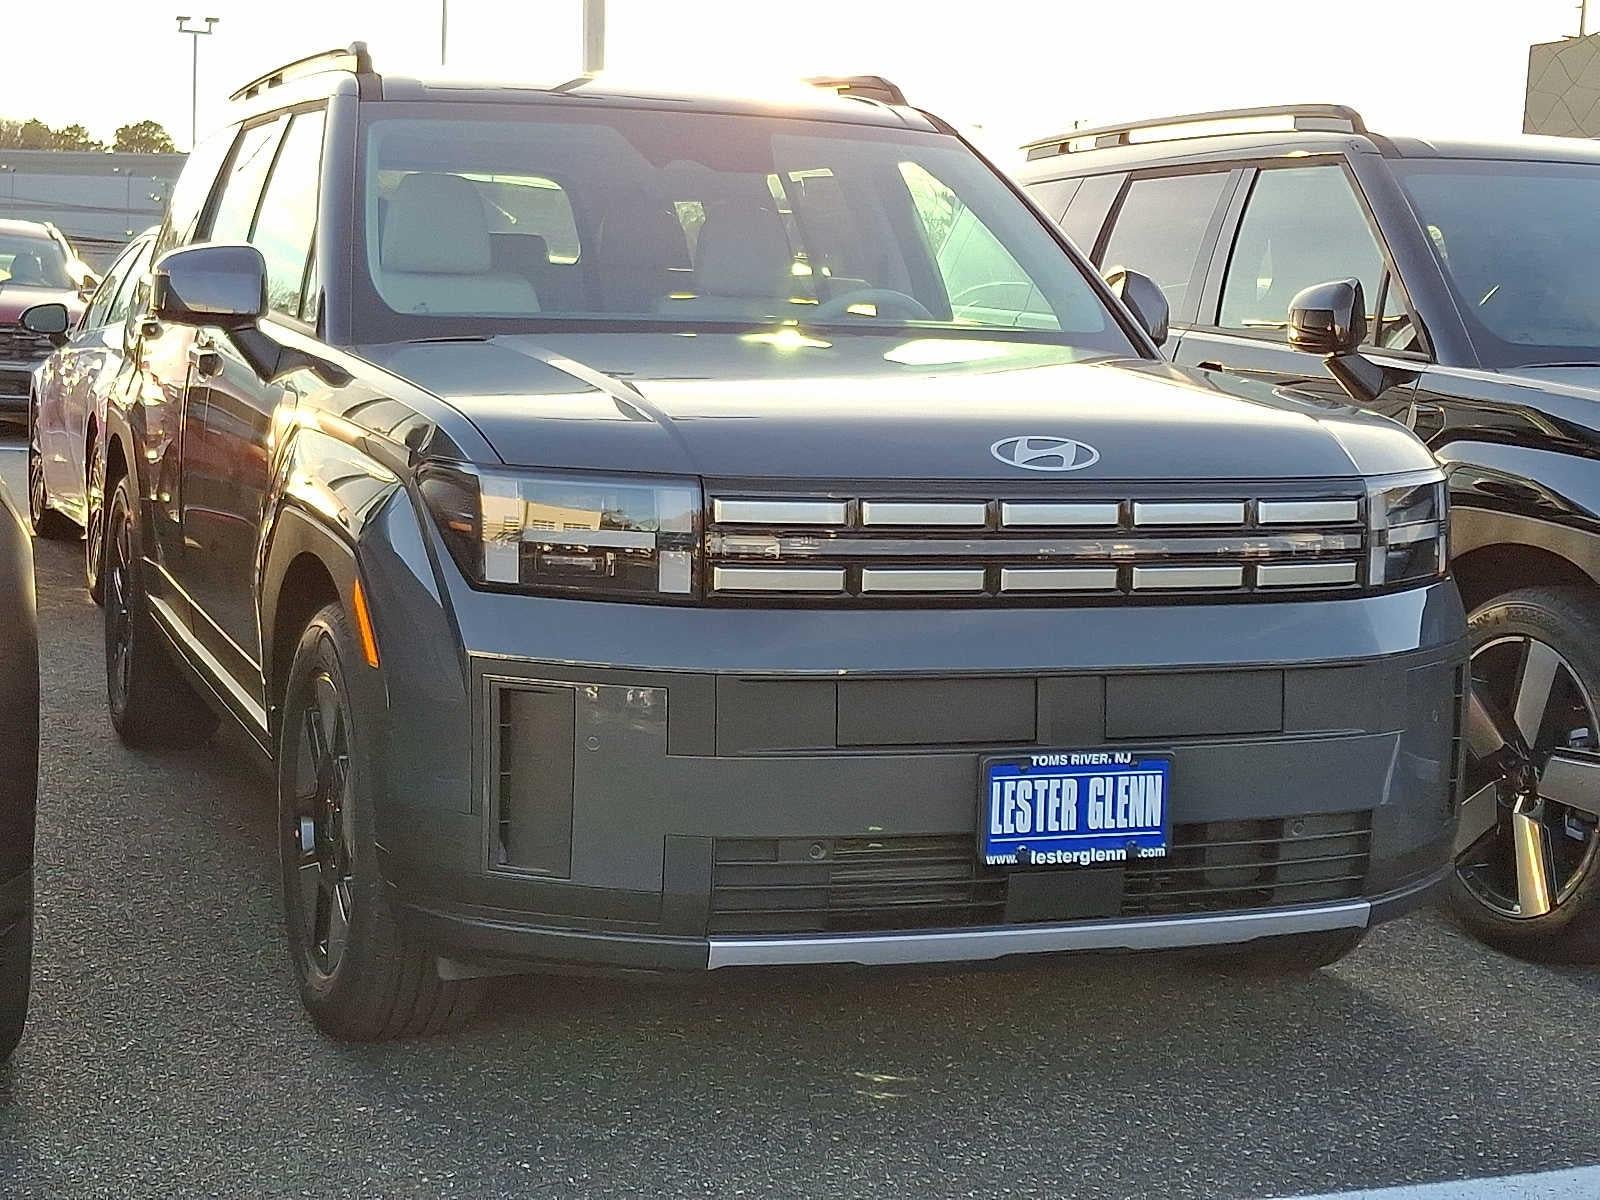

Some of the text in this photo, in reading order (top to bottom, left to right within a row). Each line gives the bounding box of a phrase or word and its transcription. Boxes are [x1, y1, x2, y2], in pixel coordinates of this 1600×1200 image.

[1031, 754, 1068, 767] TOMS
[1115, 752, 1132, 765] NJ
[991, 775, 1163, 835] LESTER GLENN
[986, 846, 1166, 866] www. lesterglenn .com
